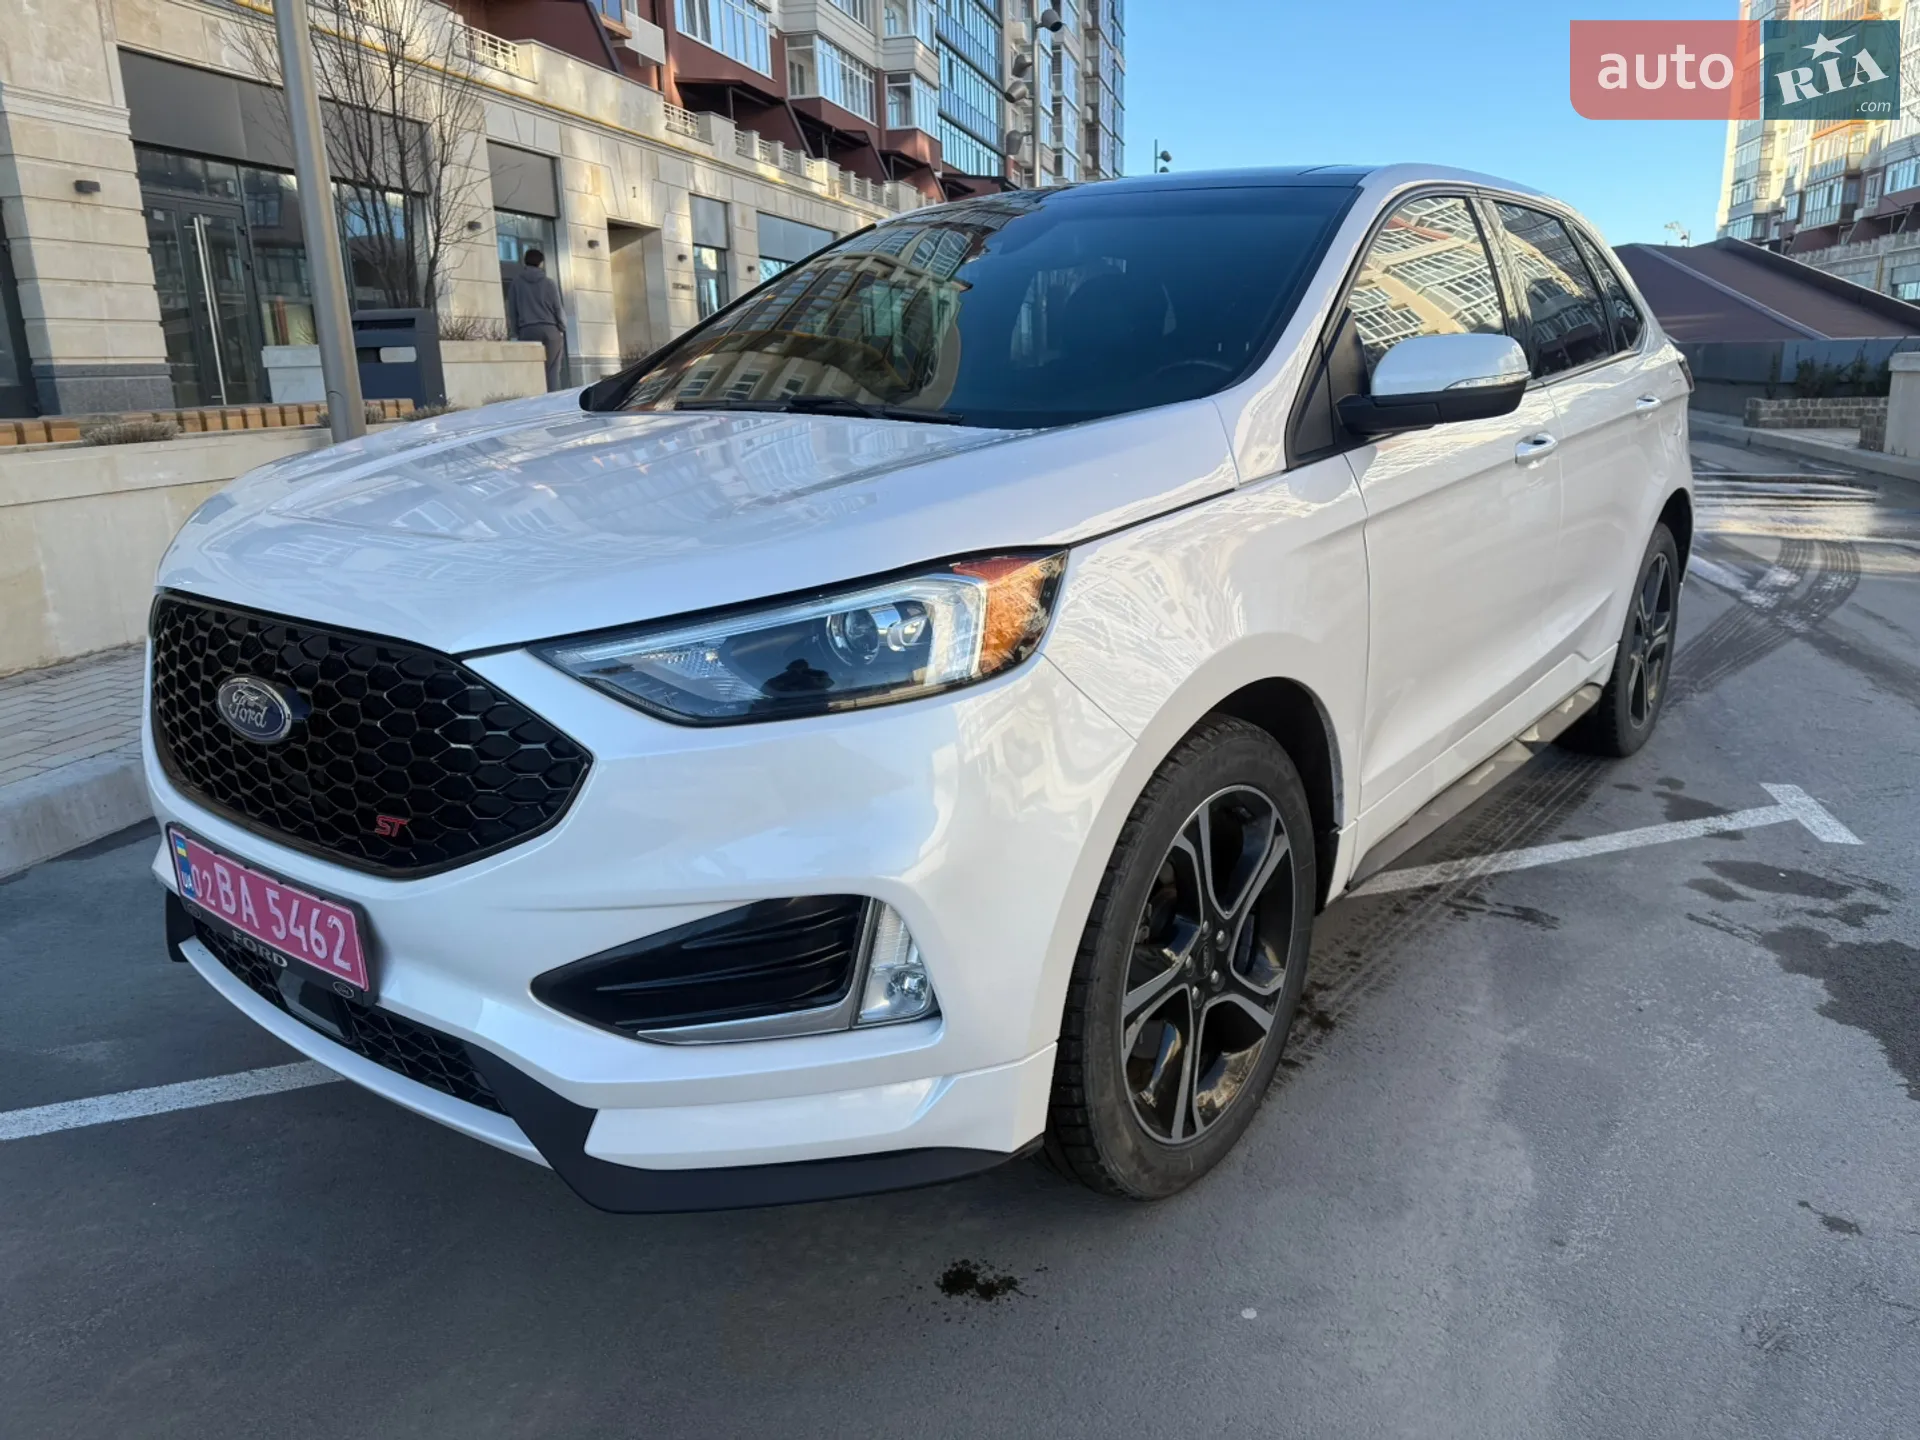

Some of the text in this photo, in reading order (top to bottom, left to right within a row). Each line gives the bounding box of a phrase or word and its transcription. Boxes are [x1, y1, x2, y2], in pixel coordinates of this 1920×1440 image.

[228, 687, 268, 729] Ford
[374, 814, 411, 837] ST
[181, 870, 195, 893] UA
[231, 929, 288, 969] FORD
[265, 886, 352, 972] 5462
